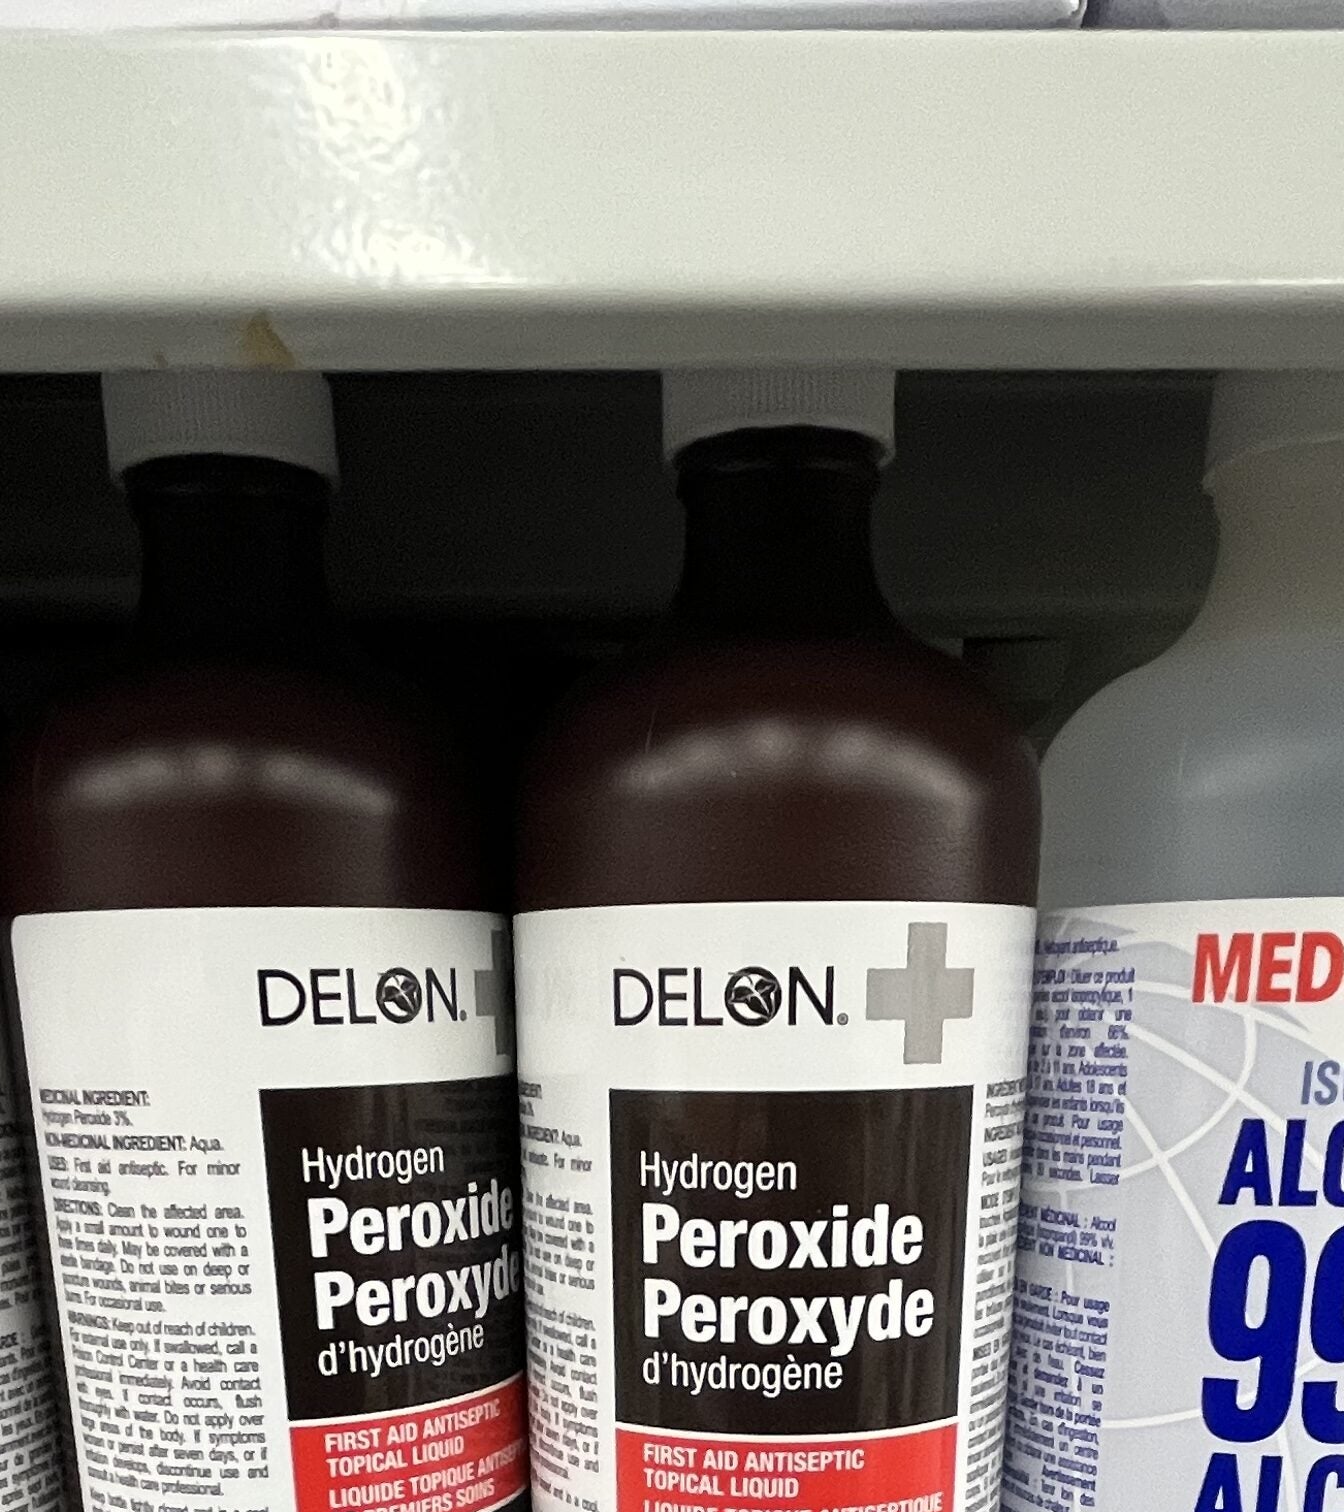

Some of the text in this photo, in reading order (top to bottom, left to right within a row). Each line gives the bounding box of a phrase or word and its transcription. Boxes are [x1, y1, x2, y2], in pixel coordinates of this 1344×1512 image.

[257, 967, 460, 1027] DELON
[613, 964, 834, 1026] DELON
[302, 1143, 445, 1189] Hydrogen
[640, 1150, 797, 1198] Hydrogen
[307, 1179, 515, 1258] Peroxide
[642, 1202, 924, 1269] Peroxide
[644, 1278, 934, 1357] Peroxyde
[643, 1443, 865, 1472] FIRST AID ANTISEPTIC
[643, 1468, 799, 1499] TOPICAL LIQUID
